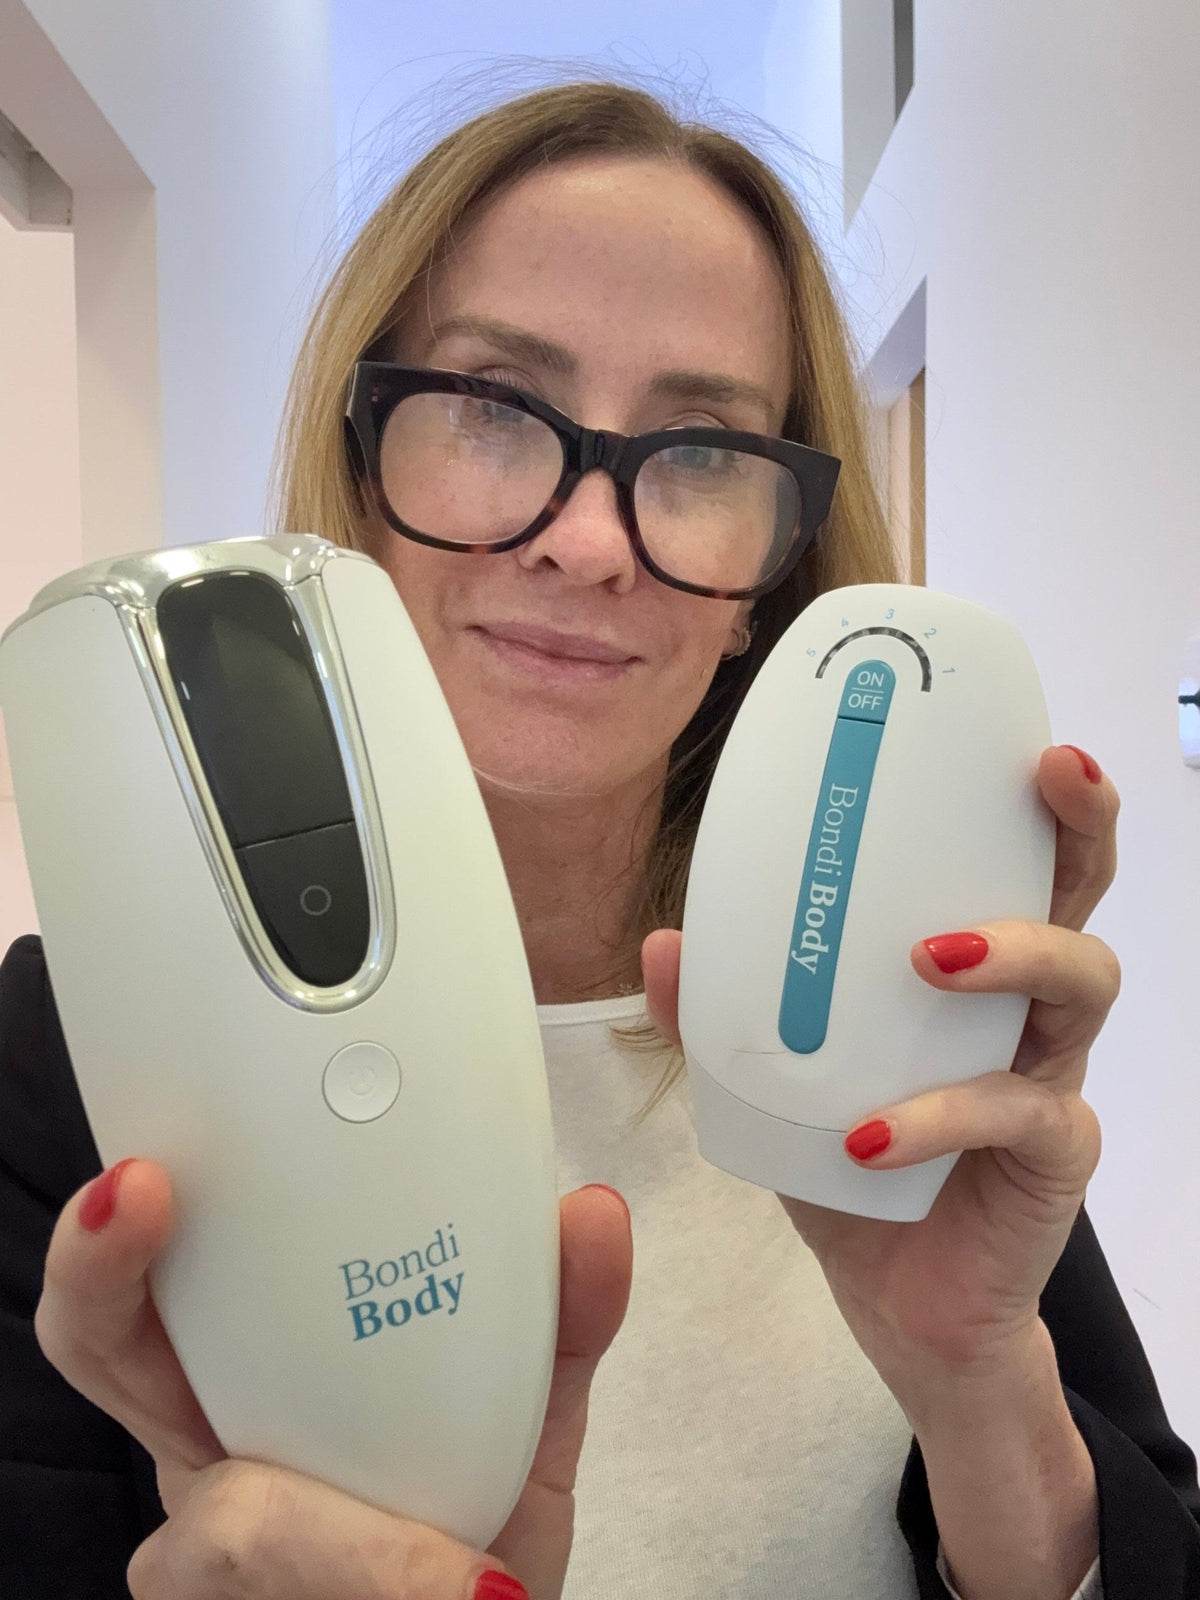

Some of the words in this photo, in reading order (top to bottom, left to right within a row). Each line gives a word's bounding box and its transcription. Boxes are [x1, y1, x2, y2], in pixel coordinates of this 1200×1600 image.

[806, 648, 816, 658] 5
[841, 618, 849, 627] 4
[885, 608, 895, 620] 3
[923, 627, 937, 639] 2
[847, 693, 883, 711] OFF
[857, 671, 885, 688] ON
[814, 783, 859, 877] Bondi
[791, 880, 839, 975] Body
[338, 1223, 460, 1301] Bondi
[347, 1272, 465, 1342] Body
